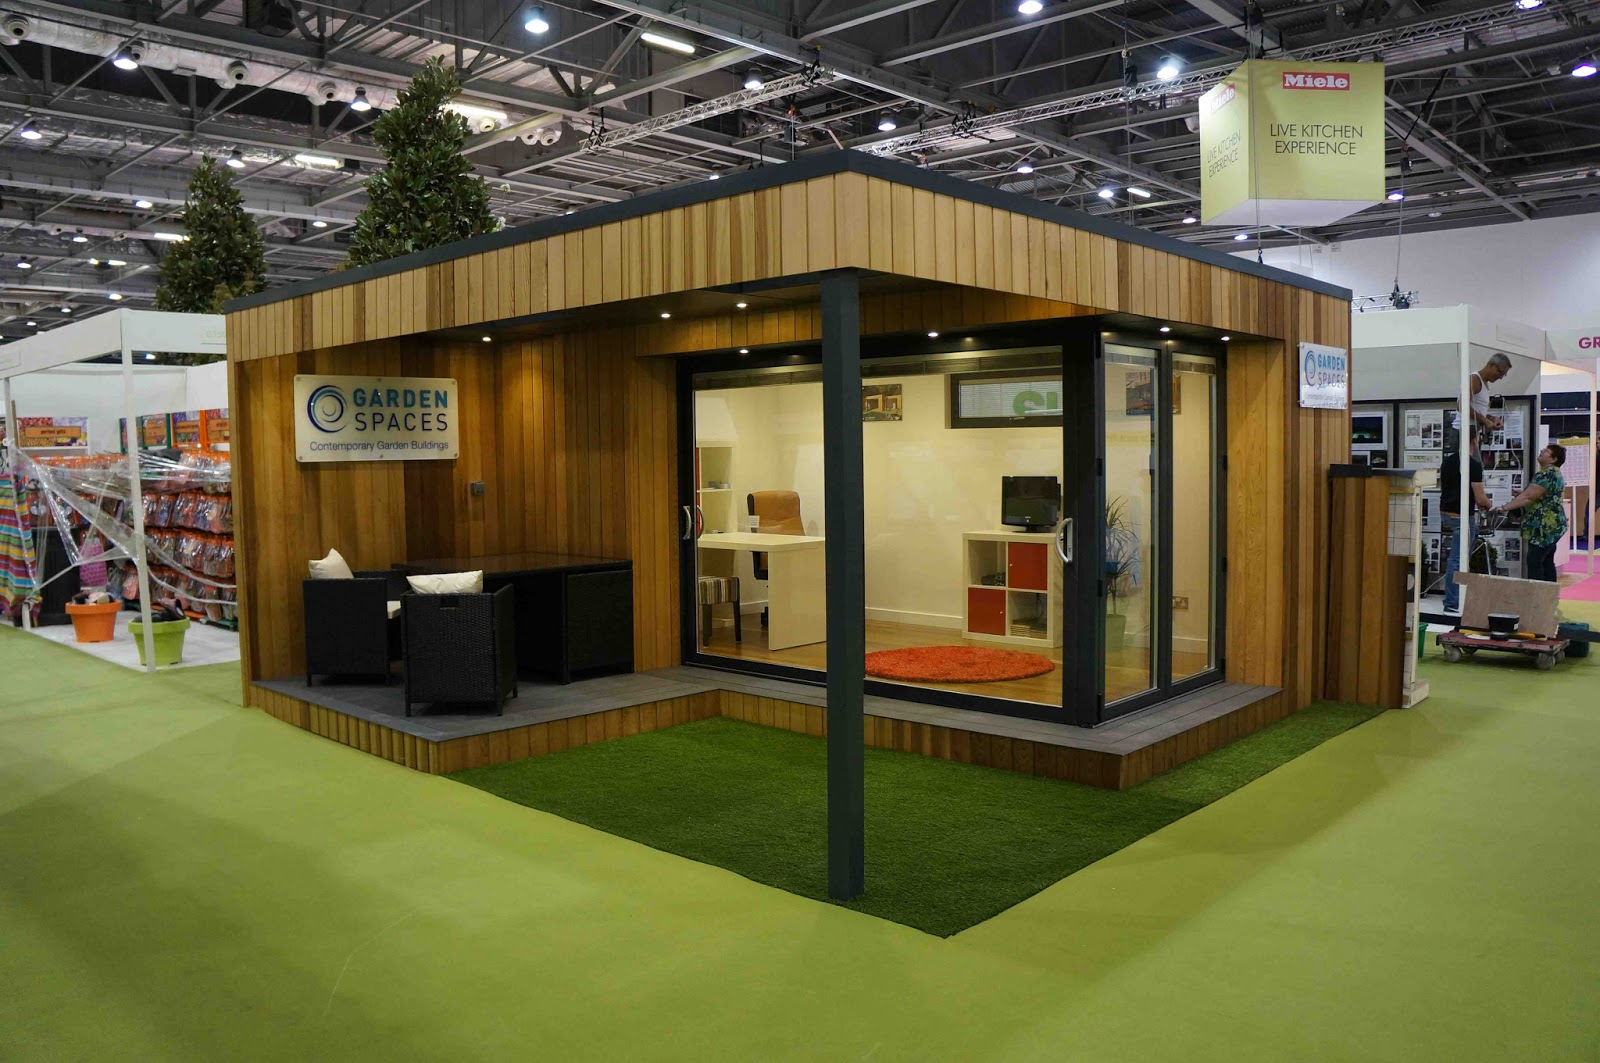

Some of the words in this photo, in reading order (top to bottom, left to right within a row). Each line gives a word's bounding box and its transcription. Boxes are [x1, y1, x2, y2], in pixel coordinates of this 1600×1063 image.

[1284, 74, 1348, 88] Miele
[1270, 124, 1297, 137] LIVE
[1301, 125, 1363, 138] KITCHEN
[1207, 146, 1217, 164] LIVE
[1217, 129, 1241, 155] KITCHEN
[1275, 141, 1356, 155] EXPERIENCE
[1208, 147, 1239, 178] EXPERIENCE
[1578, 337, 1600, 349] GR
[1318, 354, 1345, 370] GARDEN
[1318, 372, 1345, 388] SPACES
[353, 388, 448, 408] GARDEN
[355, 412, 448, 431] SPACES
[310, 441, 374, 451] Contemporary
[377, 441, 409, 450] Garden
[411, 440, 449, 451] Buildings
